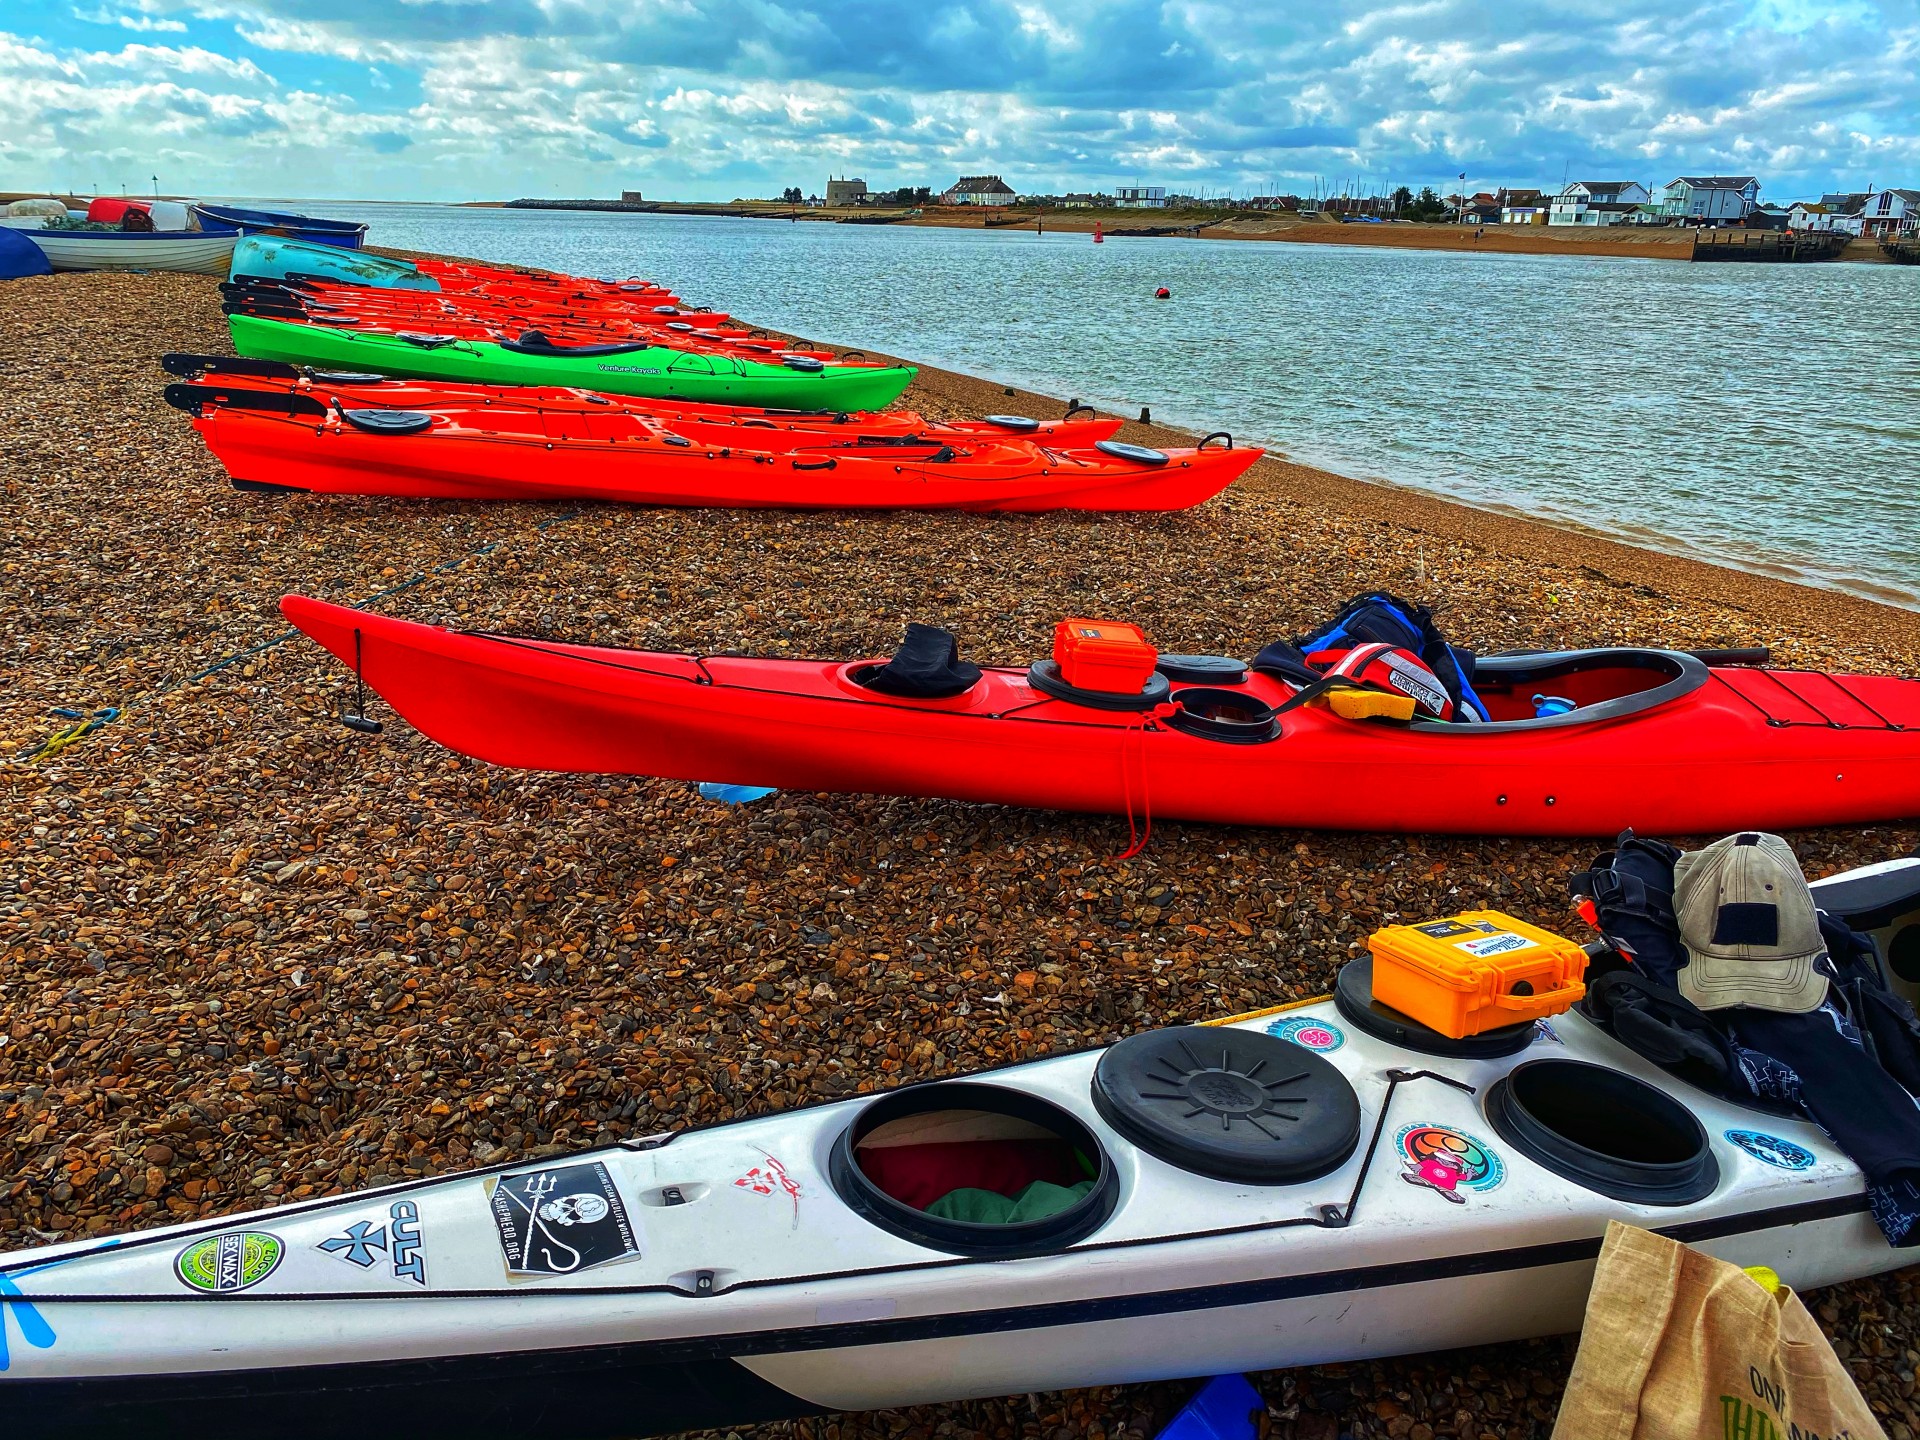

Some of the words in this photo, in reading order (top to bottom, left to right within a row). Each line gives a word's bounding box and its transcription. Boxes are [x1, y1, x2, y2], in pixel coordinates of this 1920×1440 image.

[598, 364, 630, 372] Venture
[631, 366, 661, 375] Kayaks
[609, 1197, 625, 1223] WILDLIFE
[224, 1235, 240, 1255] SEX
[390, 1201, 425, 1286] CULT
[221, 1253, 238, 1284] WAX
[251, 1248, 275, 1276] ZOGS
